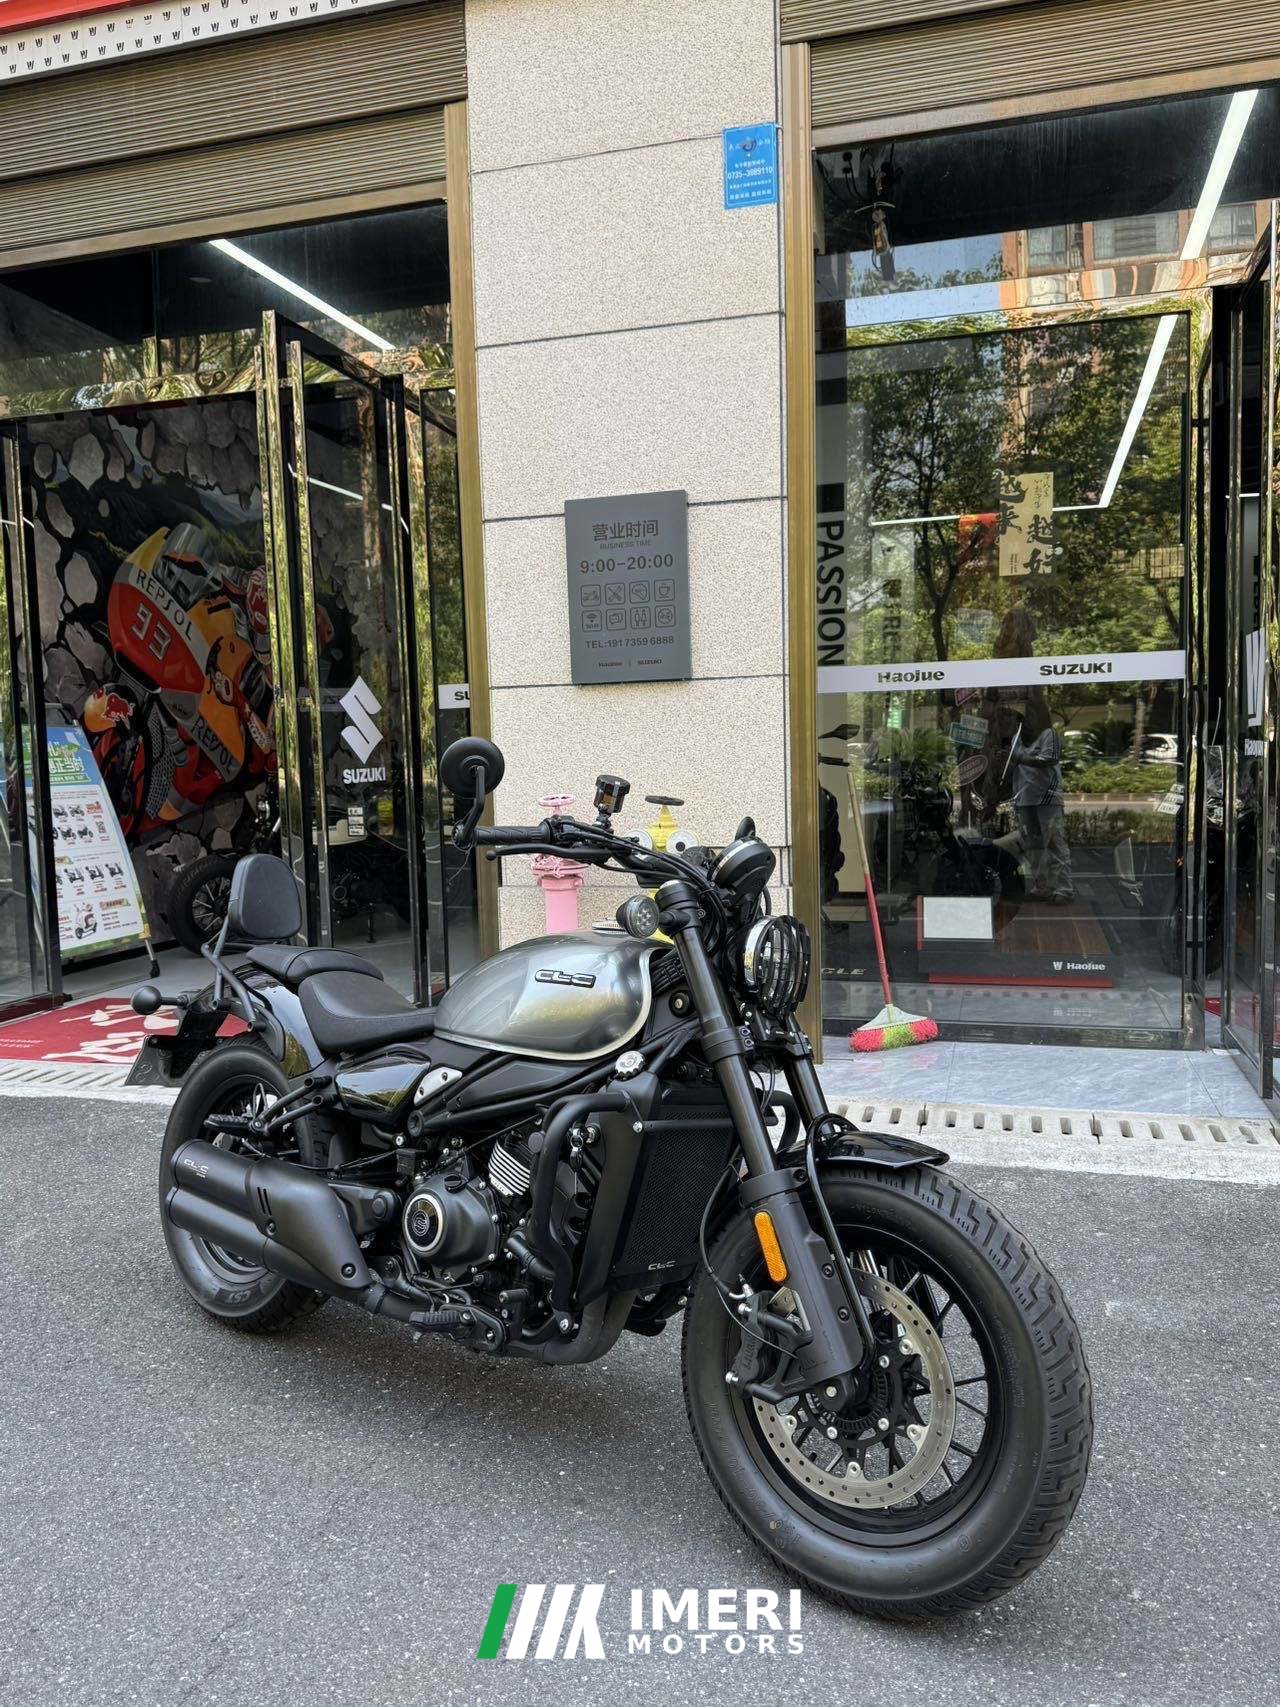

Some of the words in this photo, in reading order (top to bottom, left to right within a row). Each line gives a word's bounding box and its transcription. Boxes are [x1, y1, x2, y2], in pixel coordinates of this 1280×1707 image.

[592, 519, 659, 541] 营业时间
[599, 540, 634, 550] BUSINESS
[635, 539, 652, 547] TIME
[580, 553, 674, 574] 9:00-20:00
[816, 519, 846, 667] PASSION
[135, 569, 193, 641] REPSOL
[131, 602, 172, 661] 93
[877, 669, 945, 684] Haojue
[1039, 662, 1113, 677] SUZUKI
[342, 767, 386, 785] SUZUKI
[1066, 962, 1106, 971] Haojue
